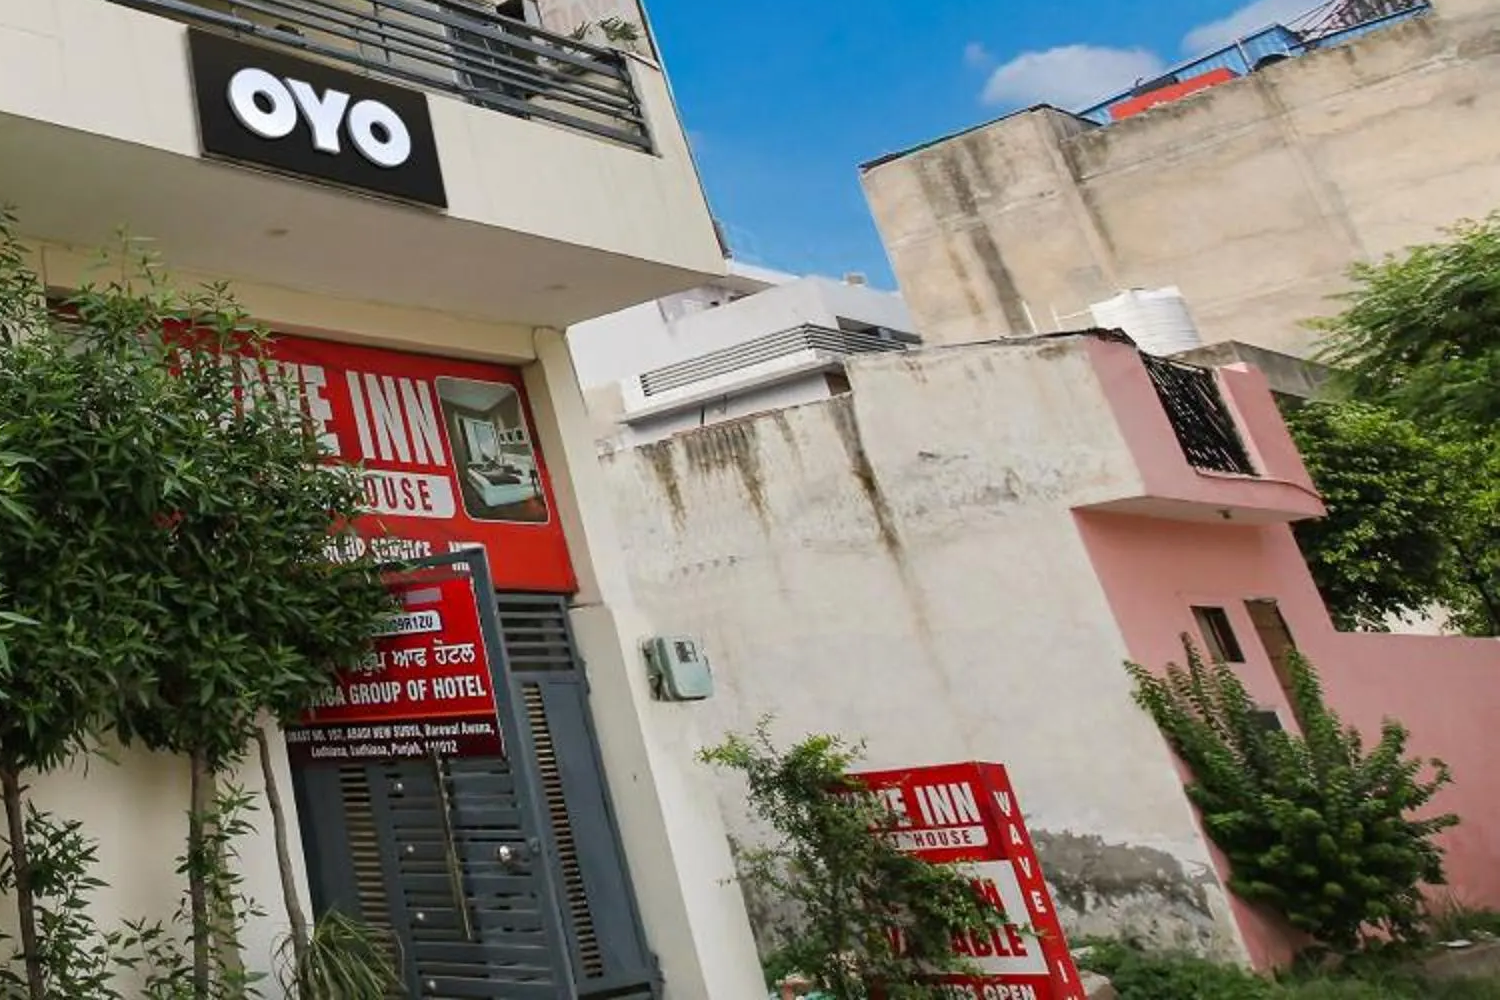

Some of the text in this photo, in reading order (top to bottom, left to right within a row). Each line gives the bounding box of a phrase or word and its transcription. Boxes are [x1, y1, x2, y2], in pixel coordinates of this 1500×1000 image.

[227, 67, 412, 168] OYO
[345, 369, 447, 467] INN
[355, 475, 432, 512] OUSE
[350, 681, 400, 705] GROUP
[407, 679, 428, 701] OF
[433, 675, 486, 700] HOTEL
[913, 781, 982, 826] INN
[913, 830, 973, 847] HOUSE
